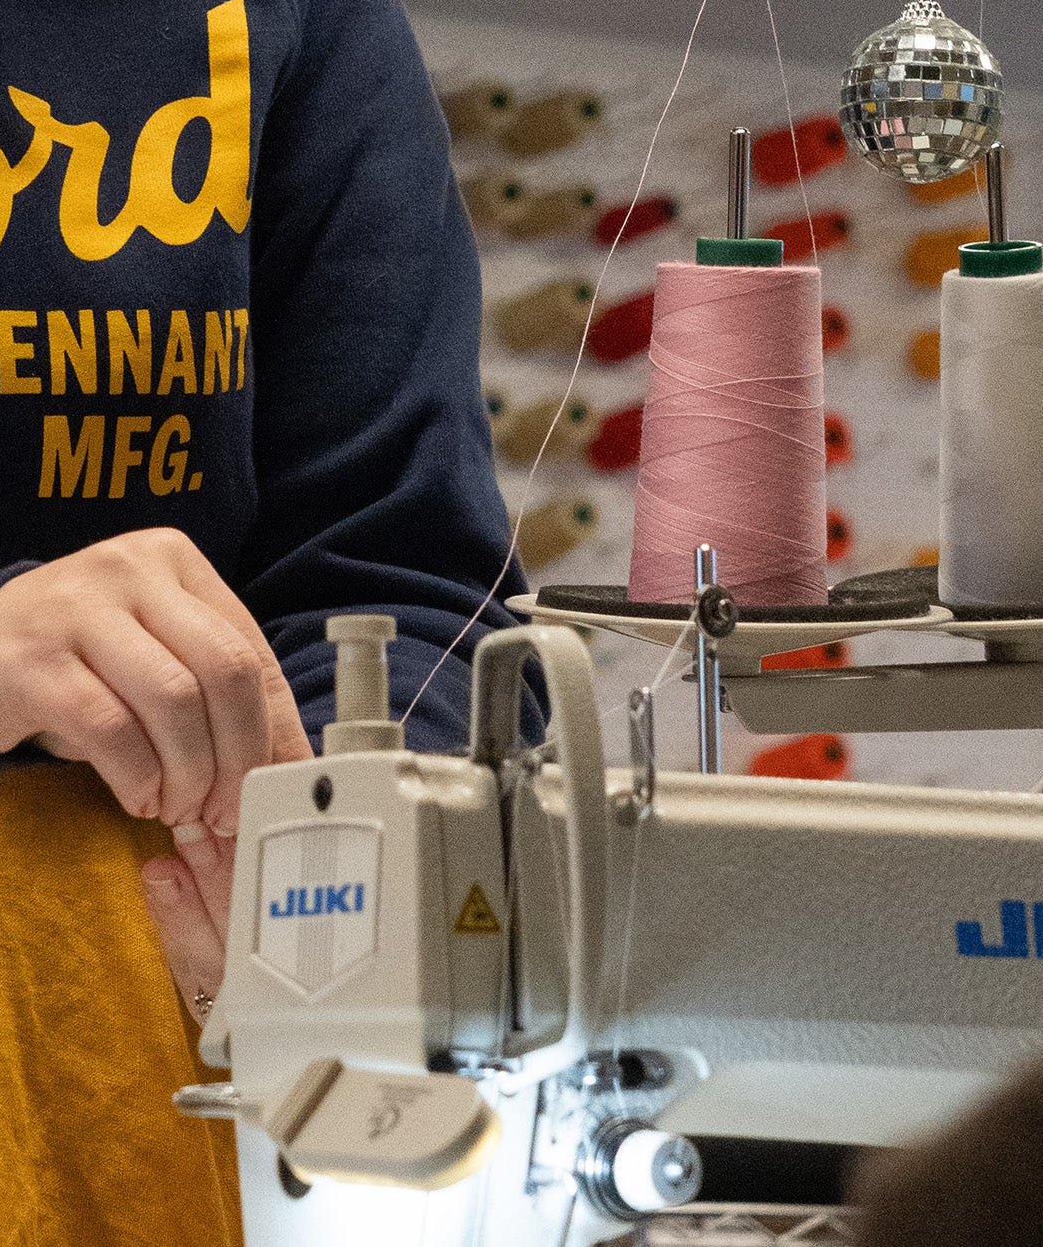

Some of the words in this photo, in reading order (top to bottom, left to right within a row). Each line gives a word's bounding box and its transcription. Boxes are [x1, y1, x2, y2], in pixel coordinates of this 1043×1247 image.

[38, 414, 204, 499] MFG.
[269, 881, 364, 919] JUKI
[956, 899, 1043, 959] J
